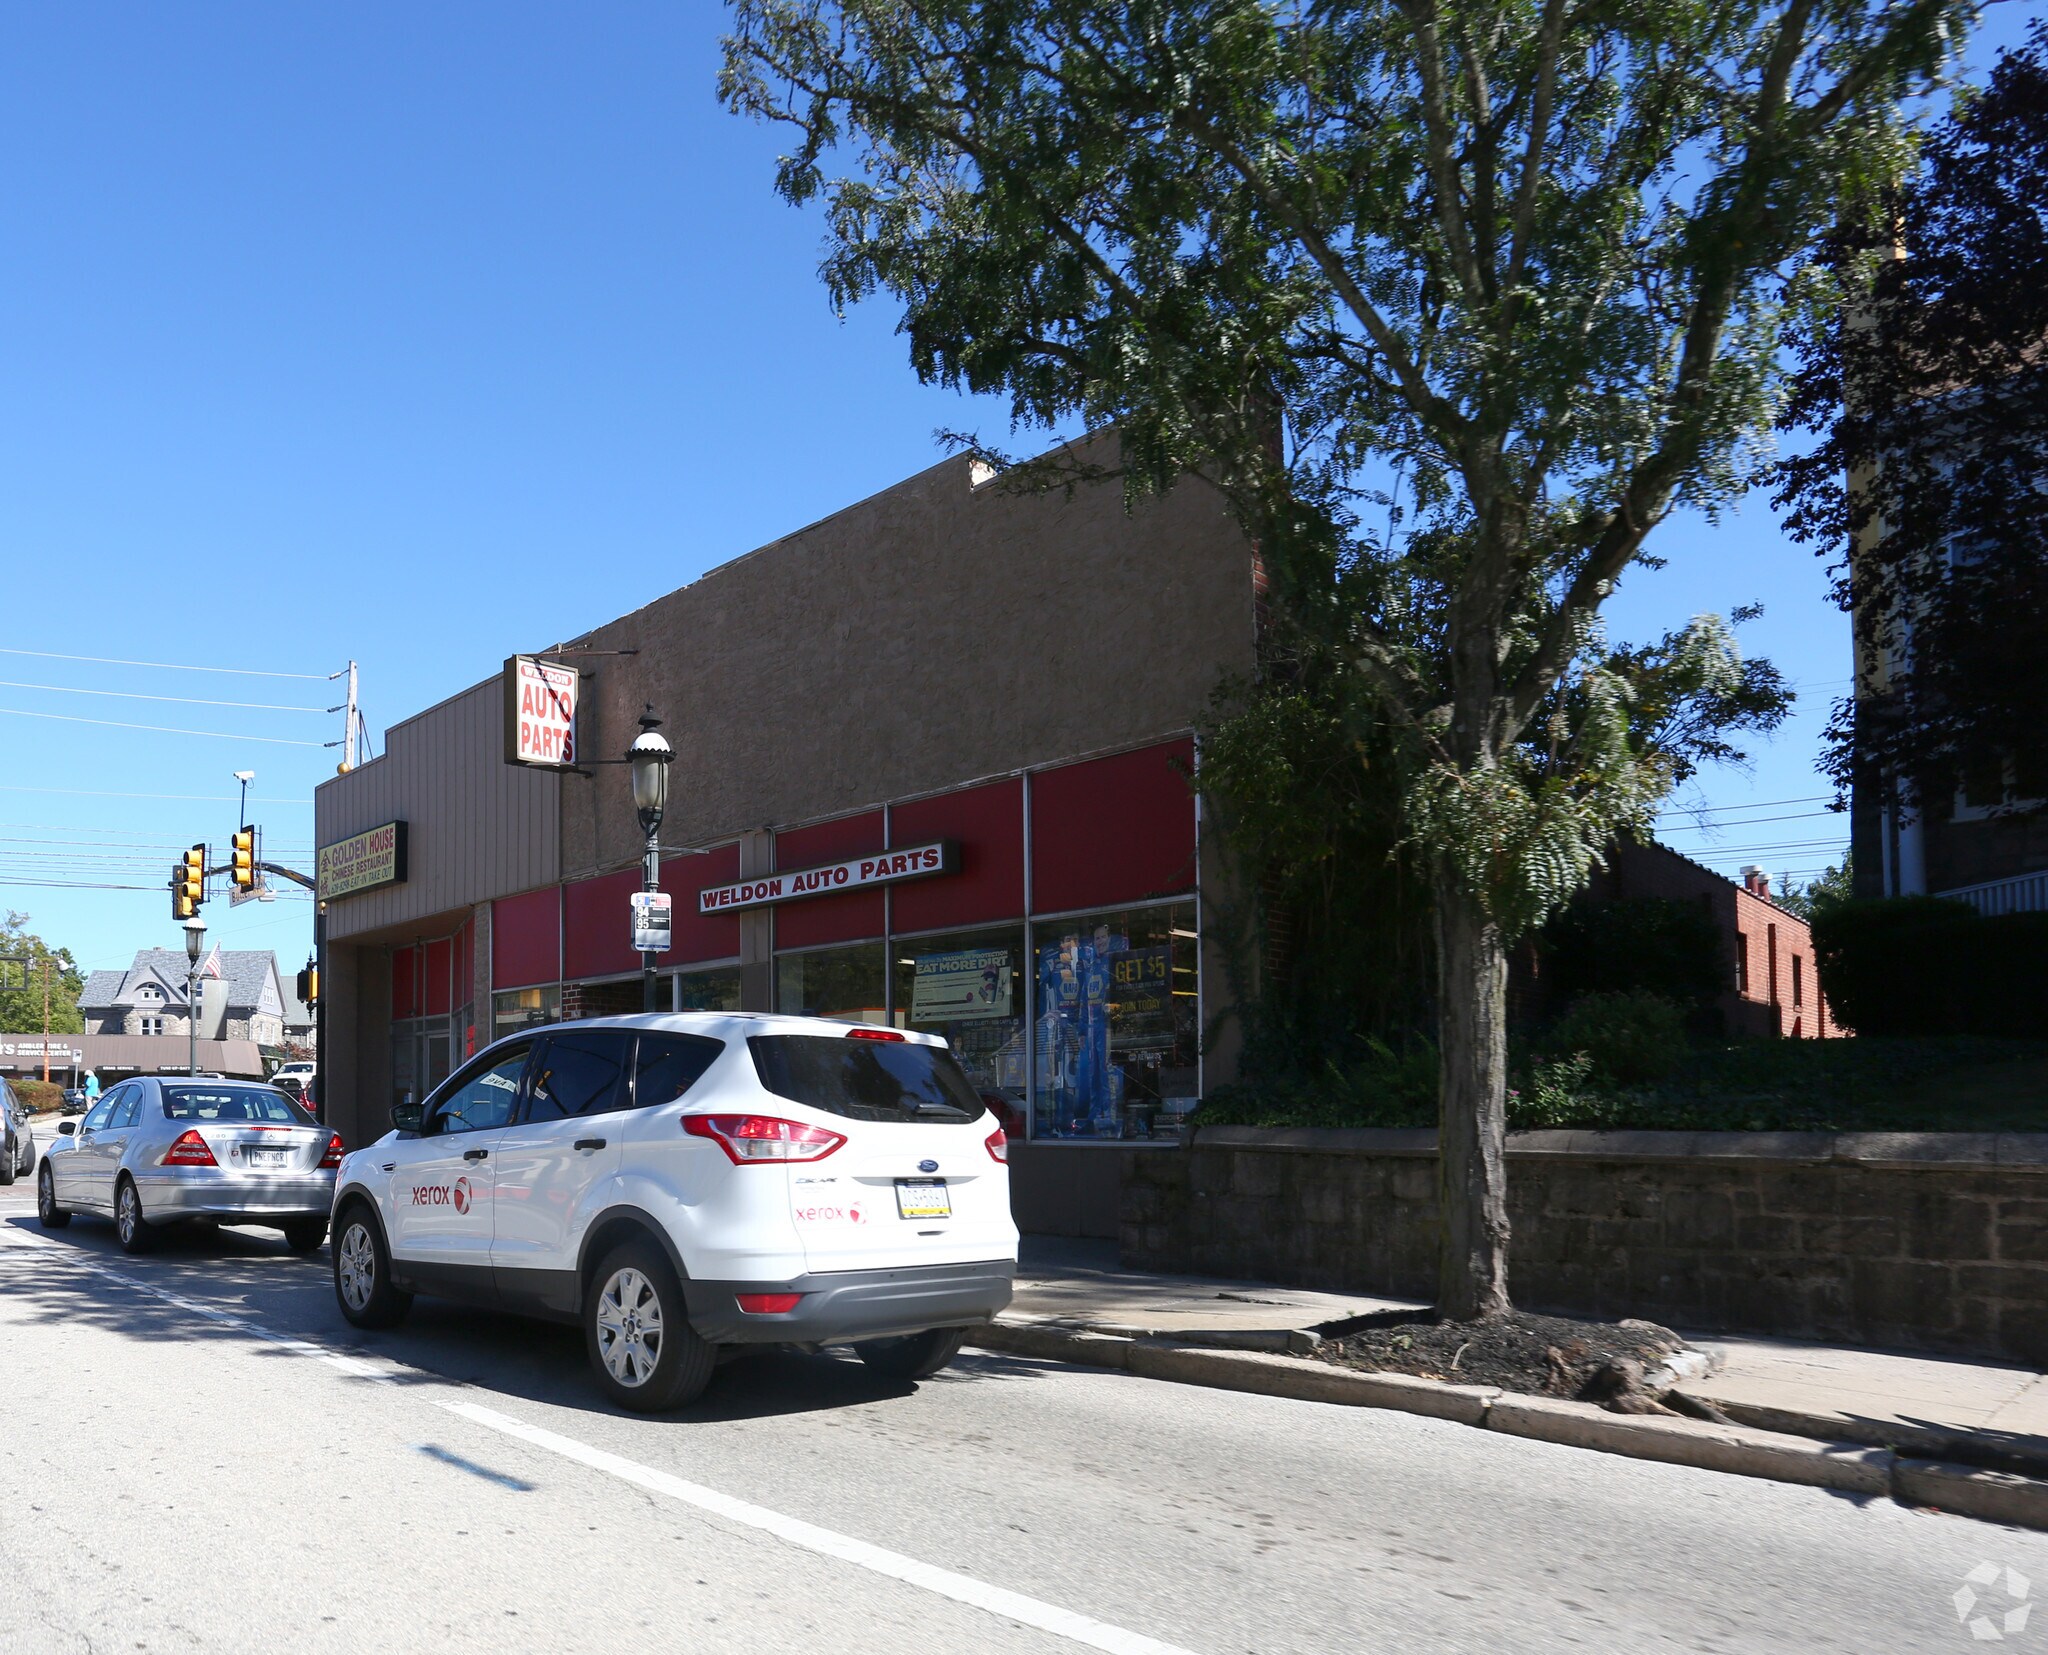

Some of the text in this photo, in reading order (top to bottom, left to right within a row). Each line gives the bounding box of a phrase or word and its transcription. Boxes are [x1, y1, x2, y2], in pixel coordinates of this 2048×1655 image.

[523, 666, 570, 685] WELDON
[521, 683, 572, 723] AUTO
[521, 721, 573, 762] PARTS
[332, 827, 394, 868] GOLDEN HOUSE
[331, 851, 393, 882] CHINESE RESTAURANT
[368, 870, 380, 882] TAKE
[381, 866, 393, 879] OUT
[702, 848, 939, 909] WELDON AUTO PARTS
[637, 906, 649, 918] 94
[637, 918, 649, 930] 95
[916, 963, 939, 974] EAT
[940, 960, 977, 972] MORE
[978, 956, 1008, 969] DIRT
[1115, 955, 1167, 983] GET $5
[1137, 998, 1161, 1011] TODAY
[16, 1049, 45, 1057] SERVICE
[412, 1183, 450, 1206] xerox
[796, 1206, 845, 1221] xerox
